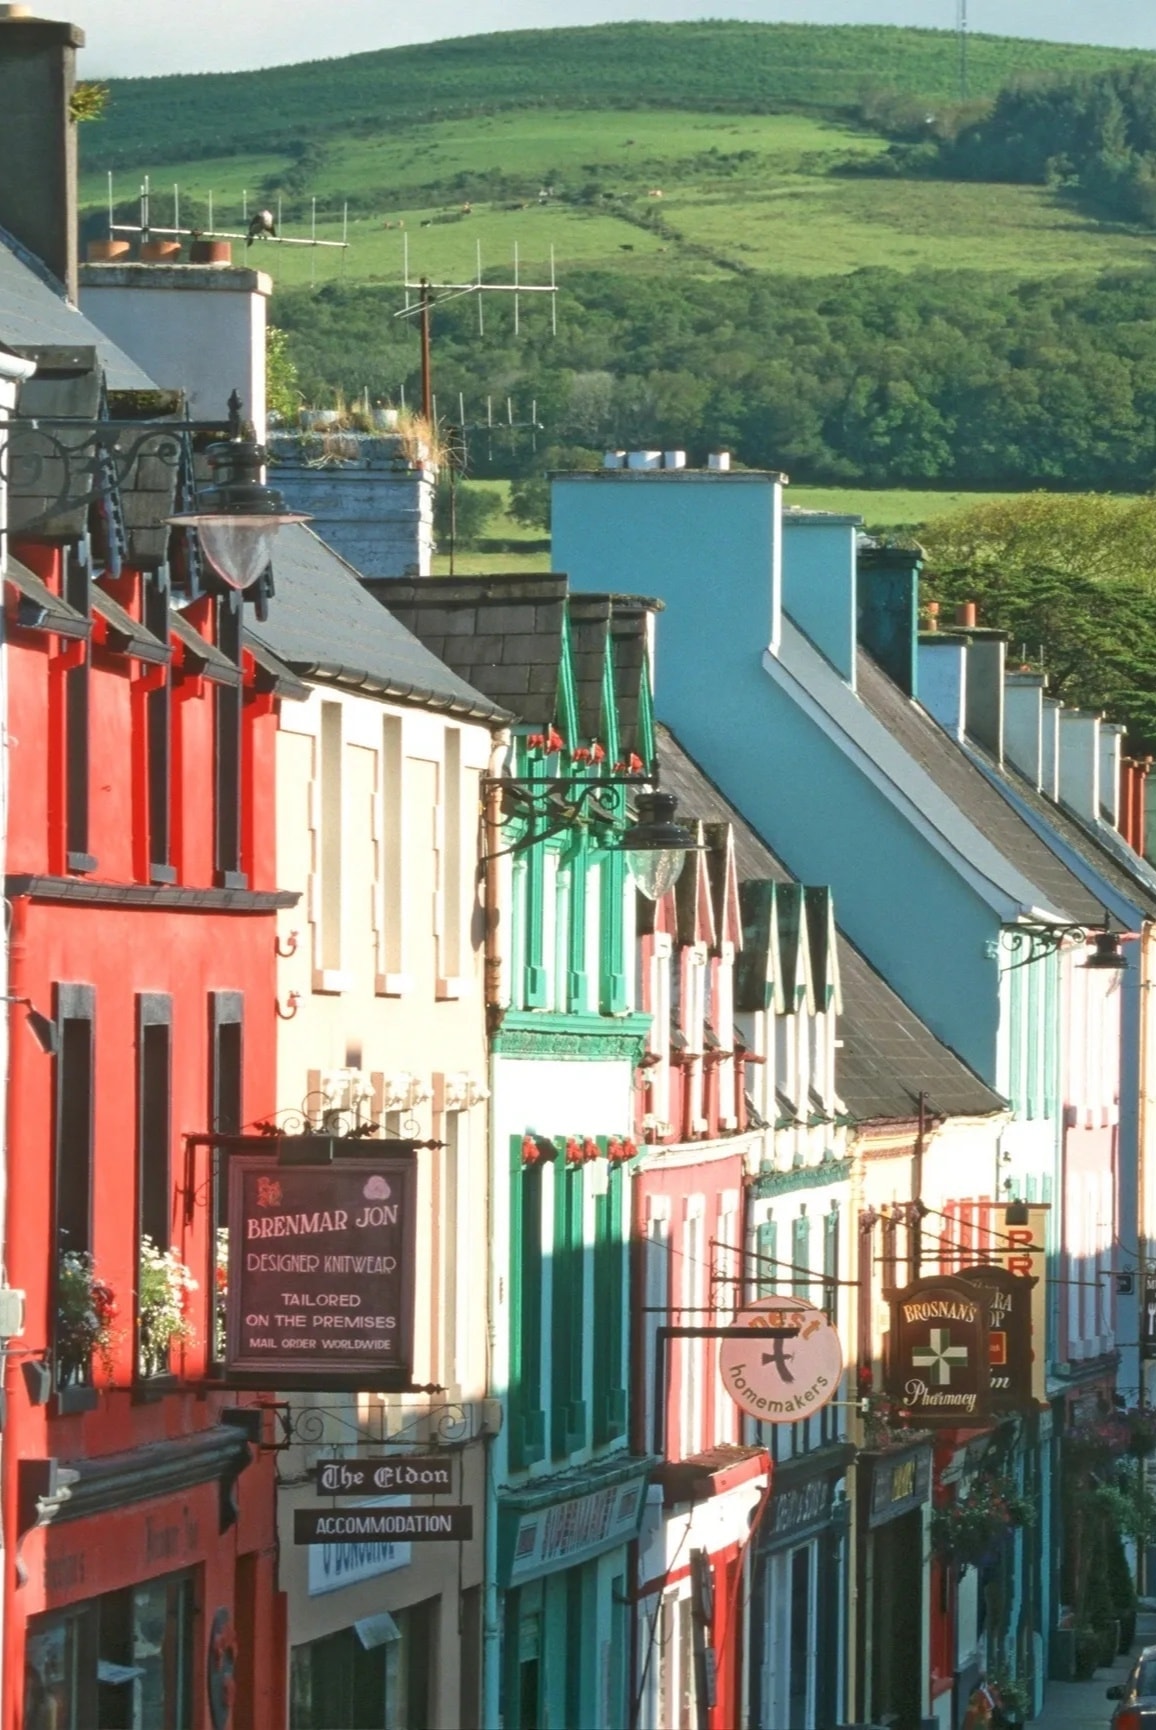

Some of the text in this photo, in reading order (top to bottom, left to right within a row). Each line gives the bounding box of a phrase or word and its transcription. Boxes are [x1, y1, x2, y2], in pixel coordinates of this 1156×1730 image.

[247, 1205, 398, 1239] BRENMAR JON
[247, 1253, 397, 1274] DESIGNER KNITWEAR
[281, 1293, 361, 1308] TAILORED
[903, 1300, 978, 1323] BROSNAN'S
[246, 1314, 396, 1329] ON THE PREMISES
[748, 1311, 821, 1341] nest
[250, 1338, 391, 1350] MAIL ORDER WORLDWIDE
[729, 1364, 828, 1412] homemakers
[903, 1378, 977, 1412] Pharmacy
[321, 1464, 449, 1489] The Eldon
[315, 1515, 452, 1534] ACCOMMODATION
